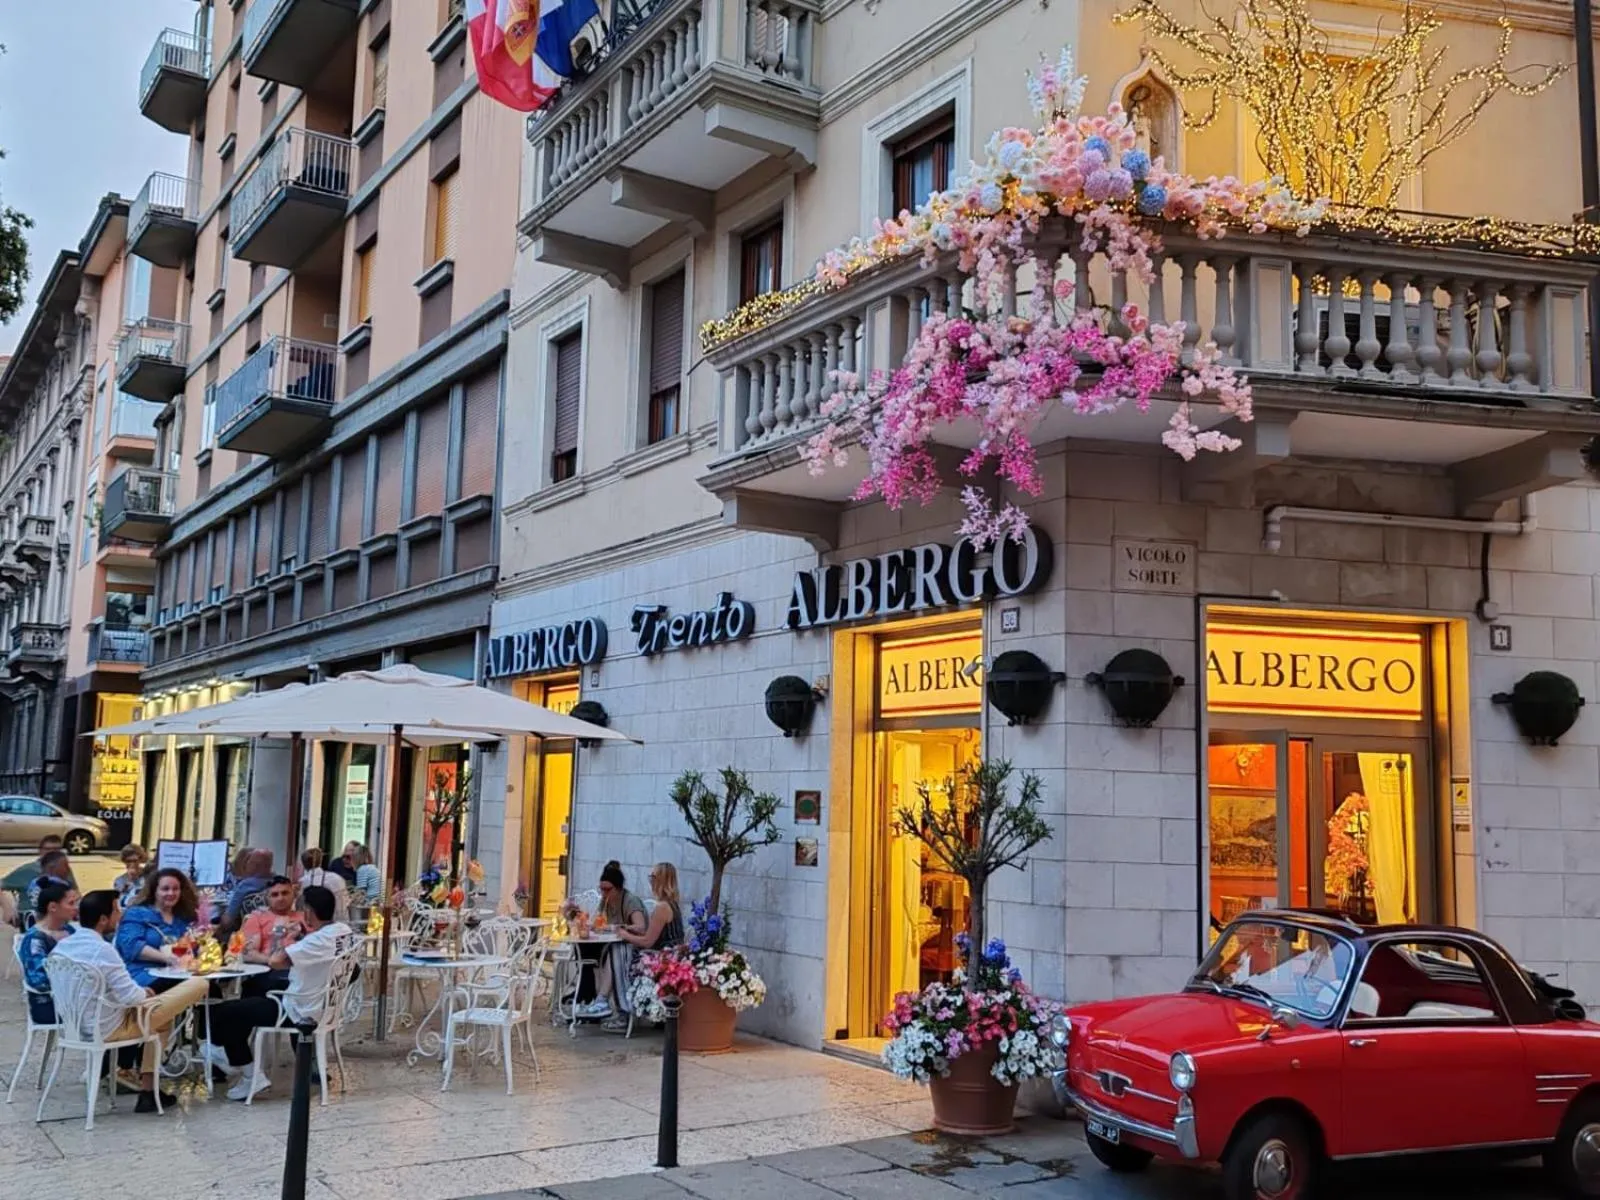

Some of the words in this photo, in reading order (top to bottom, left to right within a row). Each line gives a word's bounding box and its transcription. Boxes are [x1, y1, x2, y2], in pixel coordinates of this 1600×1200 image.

[1125, 547, 1186, 564] VICOLO
[783, 524, 1039, 629] ALBERGO
[1128, 568, 1182, 585] SORTE
[484, 616, 599, 679] ALBERGO
[633, 592, 748, 655] Trento
[1206, 649, 1415, 694] ALBERGO
[97, 810, 132, 820] EOLIA
